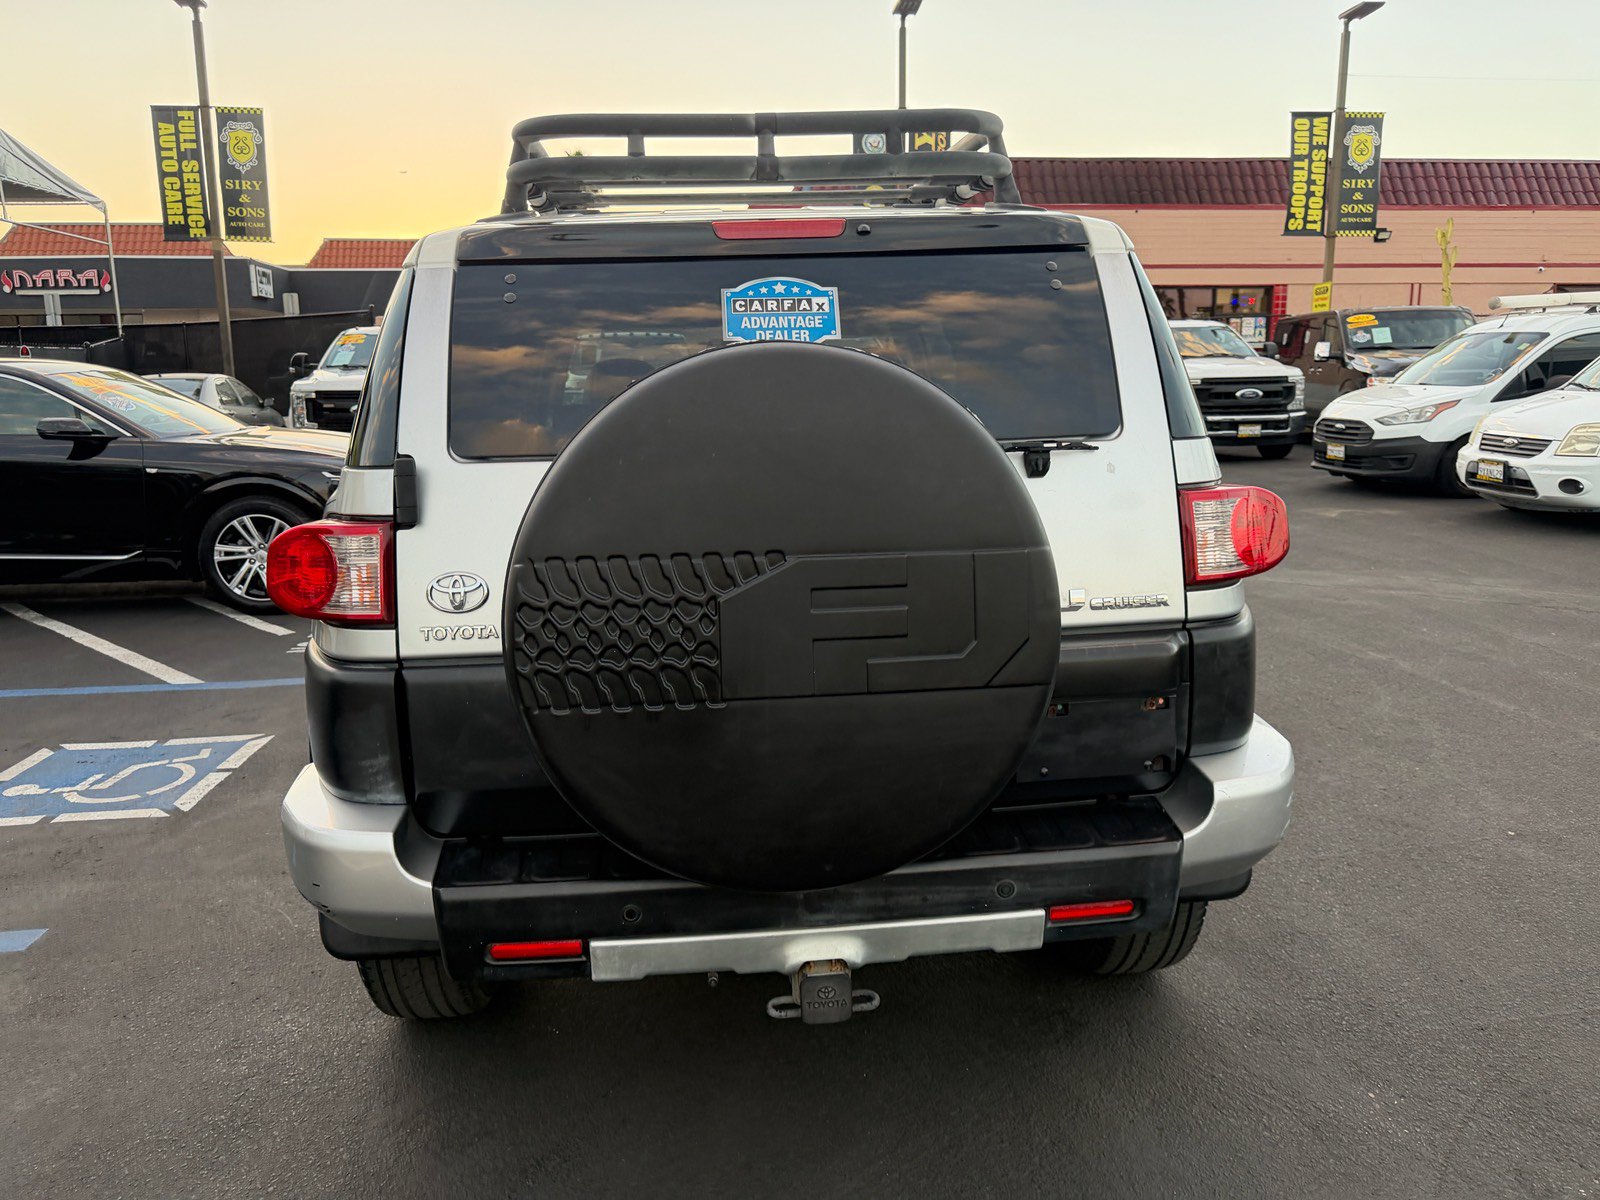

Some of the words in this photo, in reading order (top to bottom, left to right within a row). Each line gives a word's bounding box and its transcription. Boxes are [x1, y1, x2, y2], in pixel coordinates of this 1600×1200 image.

[177, 110, 197, 152] FULL
[1293, 118, 1311, 156] OUR
[1312, 117, 1329, 146] WE
[157, 122, 179, 173] AUTO
[225, 179, 263, 191] SIRY
[1306, 149, 1327, 232] SUPPORT
[1342, 179, 1376, 189] SIRY
[163, 176, 185, 225] CARE
[181, 160, 207, 238] SERVICE
[238, 194, 252, 203] &
[1287, 158, 1309, 230] TROOPS
[1352, 192, 1364, 200] &
[227, 206, 266, 218] SONS
[1340, 203, 1374, 214] SONS
[734, 298, 827, 312] CARFAX
[740, 315, 823, 329] ADVANTAGE
[755, 329, 810, 342] DEALER
[1089, 593, 1170, 611] CRUISER
[419, 625, 500, 641] TOYOTA
[805, 998, 848, 1009] TOYOTA
